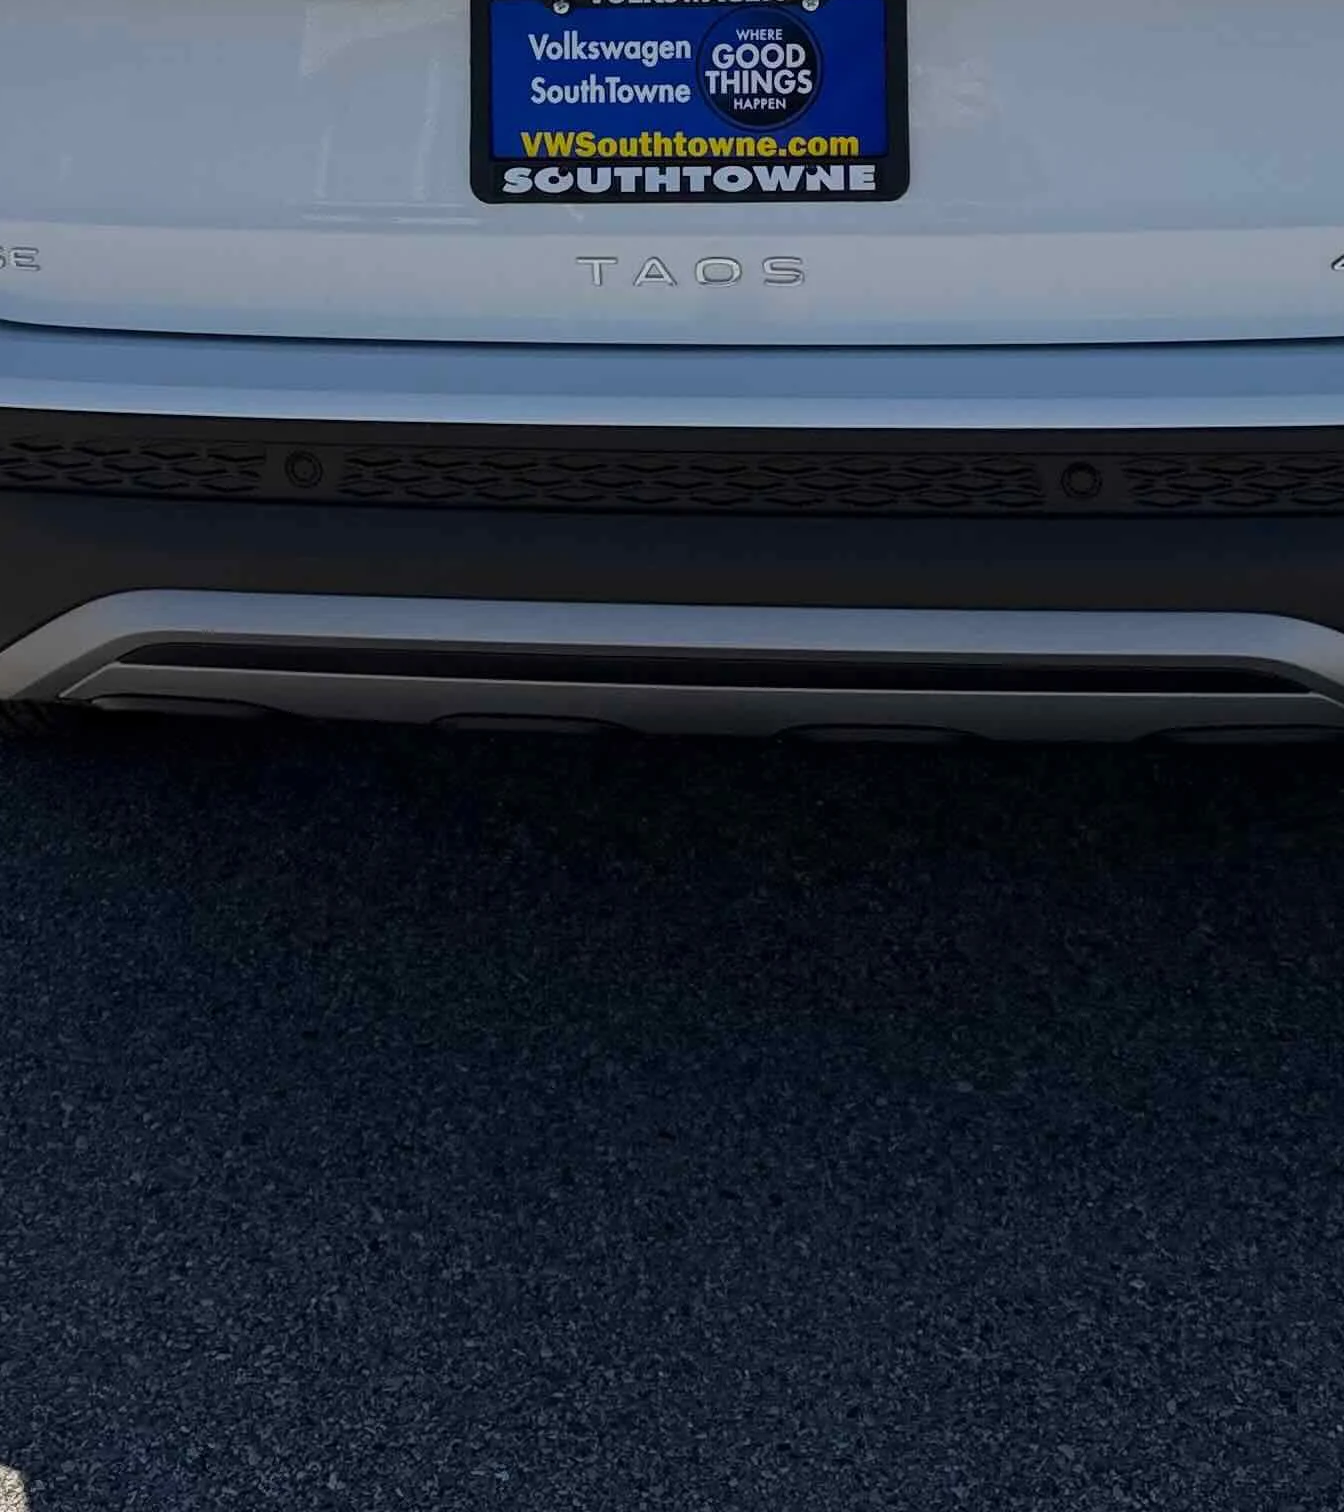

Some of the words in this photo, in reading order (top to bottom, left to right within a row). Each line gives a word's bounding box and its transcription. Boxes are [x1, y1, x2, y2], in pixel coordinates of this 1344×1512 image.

[735, 28, 783, 42] WHERE
[528, 31, 692, 67] Volkswagen
[711, 43, 806, 69] GOOD
[530, 75, 692, 104] SouthTowne
[705, 69, 813, 96] THINGS
[733, 97, 787, 111] HAPPEN
[520, 131, 859, 158] VWSouthtowne.com
[502, 164, 877, 194] SOUTHTOWNE
[576, 255, 807, 288] TAOS
